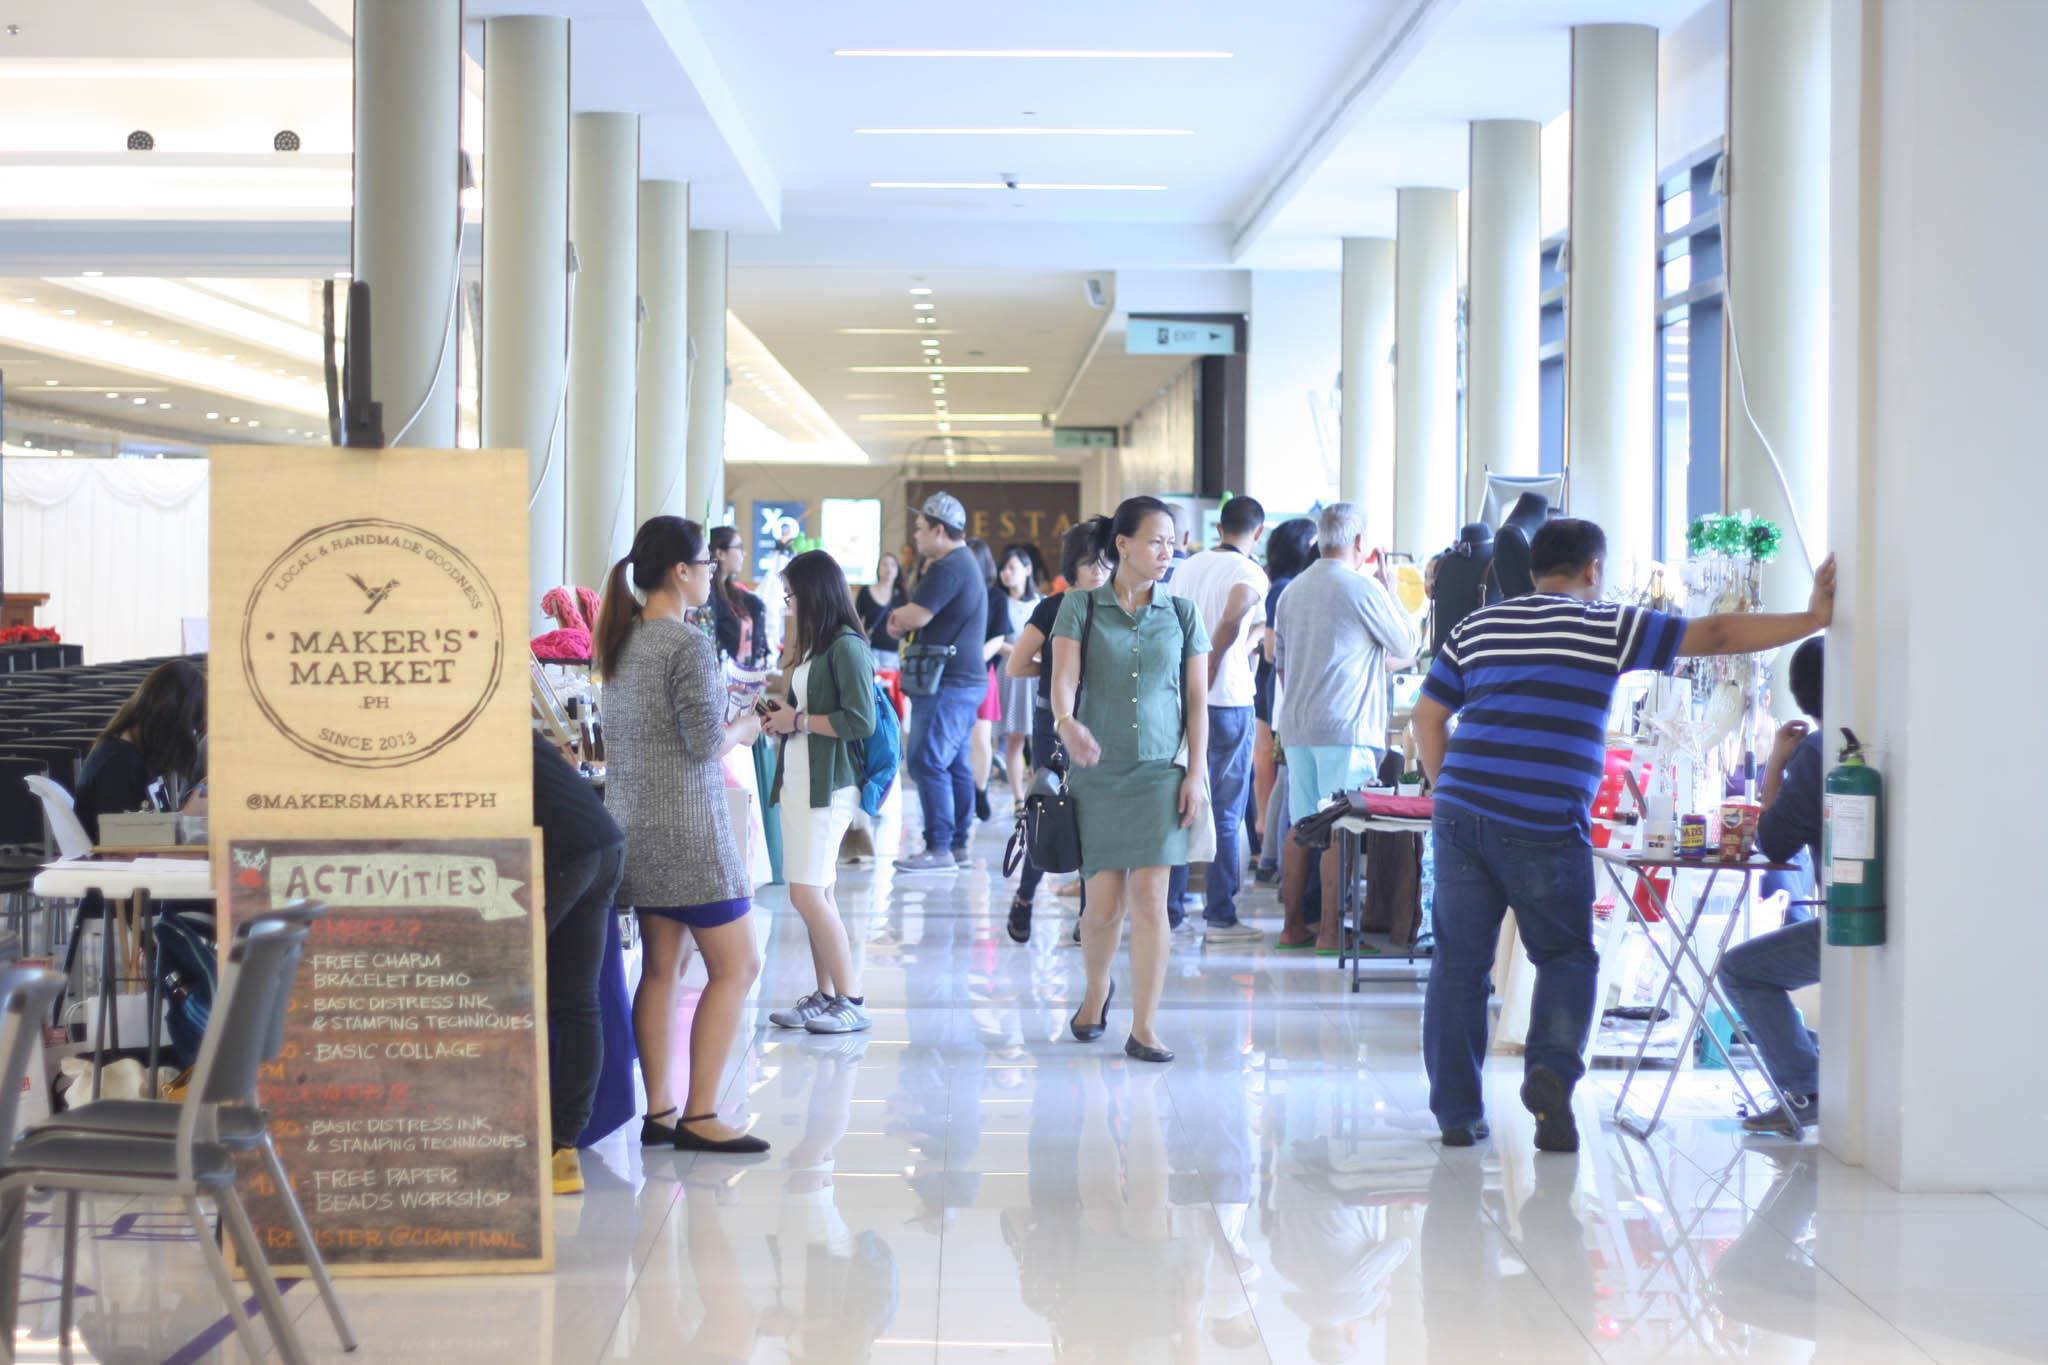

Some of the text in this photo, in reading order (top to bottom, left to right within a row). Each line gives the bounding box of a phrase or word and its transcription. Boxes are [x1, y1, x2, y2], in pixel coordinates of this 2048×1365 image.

[972, 510, 1076, 539] ESTA
[275, 533, 483, 611] LOCAL & HANDMADE GOODNESS
[289, 630, 462, 655] MAKER'S
[289, 659, 456, 685] MARKET
[318, 728, 417, 751] SINCE 2013
[246, 792, 497, 810] @MAKERSMARKETPH
[311, 952, 441, 970] FREE CHARM
[313, 972, 471, 990] BRACELET DEMO
[313, 996, 364, 1013] BASIC
[368, 995, 453, 1011] DISTRESS
[457, 994, 494, 1010] INK
[311, 1016, 329, 1031] &
[330, 1015, 418, 1031] STAMPING
[314, 1042, 378, 1061] BASIC
[384, 1041, 482, 1059] COLLAGE
[311, 1120, 362, 1136] BASIC
[367, 1116, 453, 1134] DISTRESS
[306, 1134, 528, 1152] & STAMPING TECHNIQUES
[314, 1170, 376, 1189] FREE
[386, 1167, 458, 1187] PAPER
[317, 1190, 511, 1212] BEADS WORKSHOP
